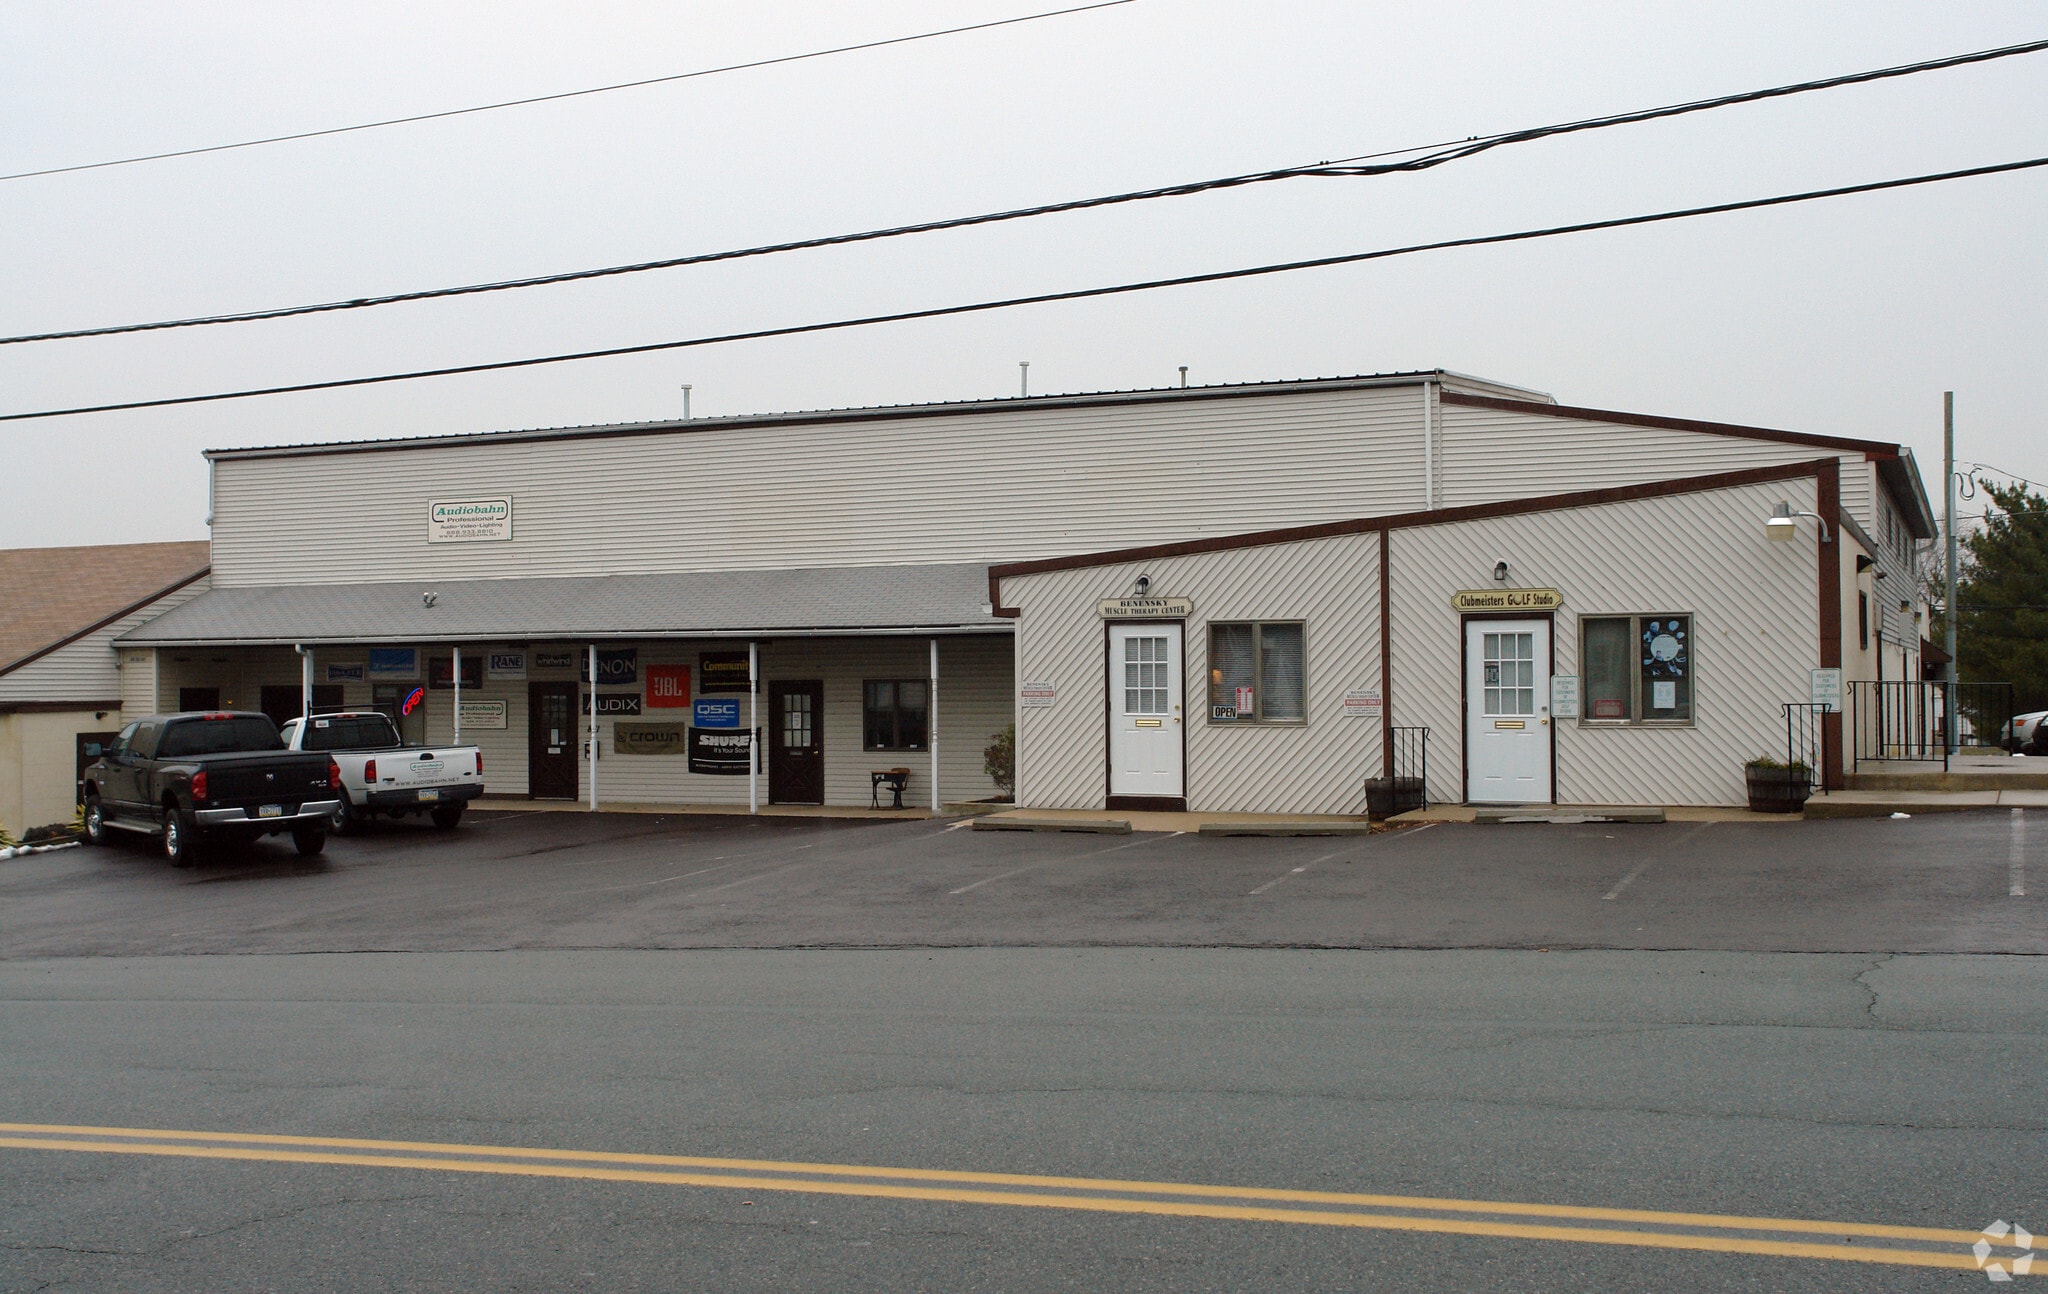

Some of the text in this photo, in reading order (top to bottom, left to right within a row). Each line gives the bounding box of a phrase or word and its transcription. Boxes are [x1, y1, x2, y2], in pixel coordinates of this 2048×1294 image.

[436, 504, 504, 516] Audiobahn
[1460, 593, 1554, 606] Clubmeisters GOLF Studio
[1131, 606, 1159, 614] THERAPY
[1161, 606, 1185, 614] CENTER
[491, 654, 521, 669] RANE
[582, 657, 636, 674] DNON
[703, 660, 750, 672] Communit
[655, 677, 682, 697] JBL
[402, 687, 424, 716] OPEN
[698, 705, 736, 714] QSC
[1215, 707, 1236, 717] OPEN
[630, 732, 680, 742] crown
[698, 735, 749, 746] SHURE
